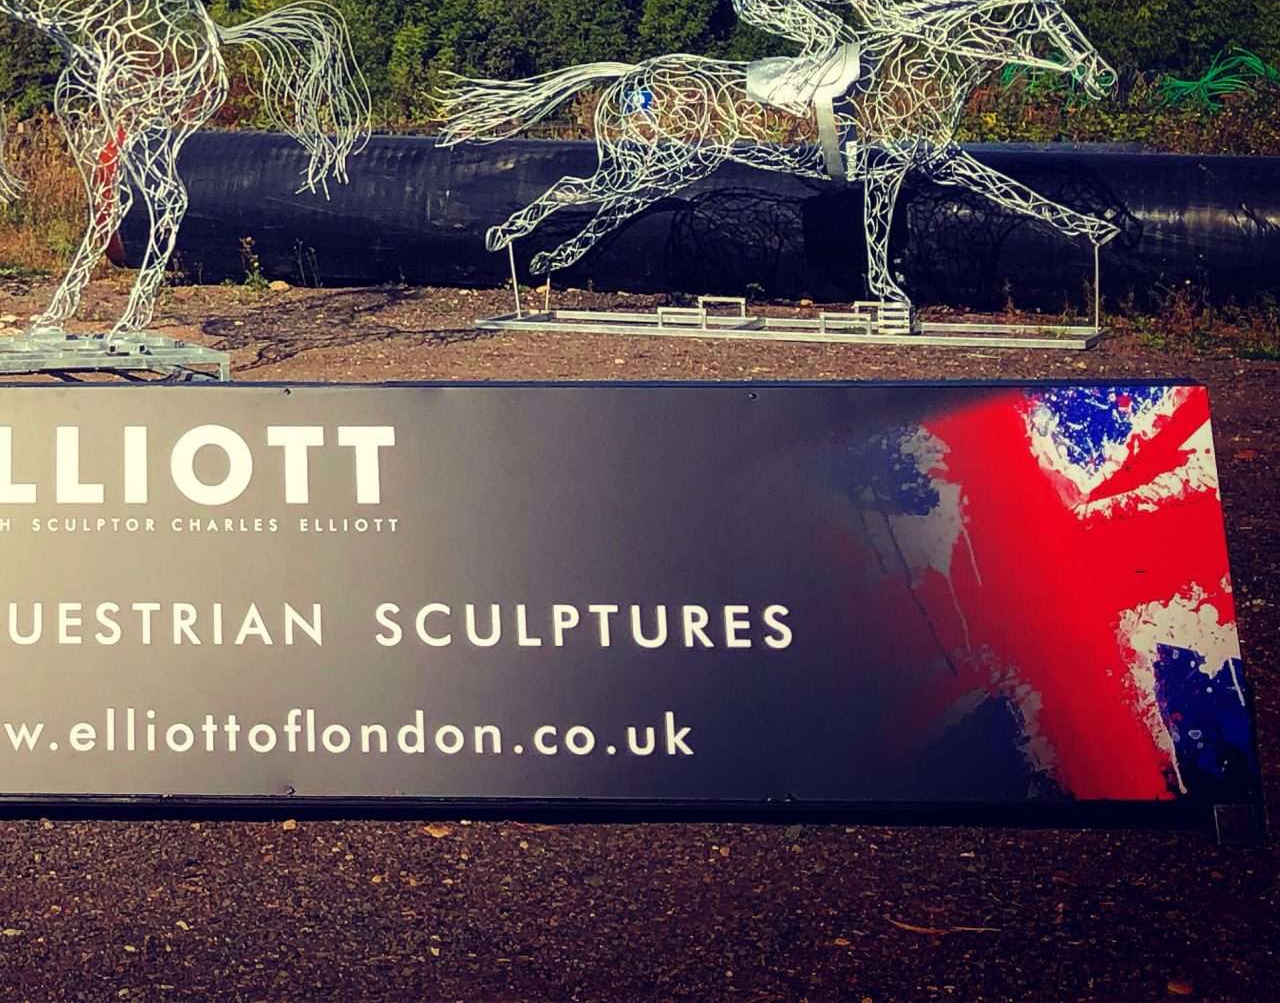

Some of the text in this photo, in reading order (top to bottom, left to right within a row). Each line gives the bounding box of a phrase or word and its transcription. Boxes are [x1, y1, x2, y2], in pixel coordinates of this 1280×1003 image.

[31, 518, 157, 533] SCULPTOR
[171, 518, 279, 533] CHARLES
[299, 518, 400, 533] ELLIOTT
[375, 602, 794, 649] SCULPTURES
